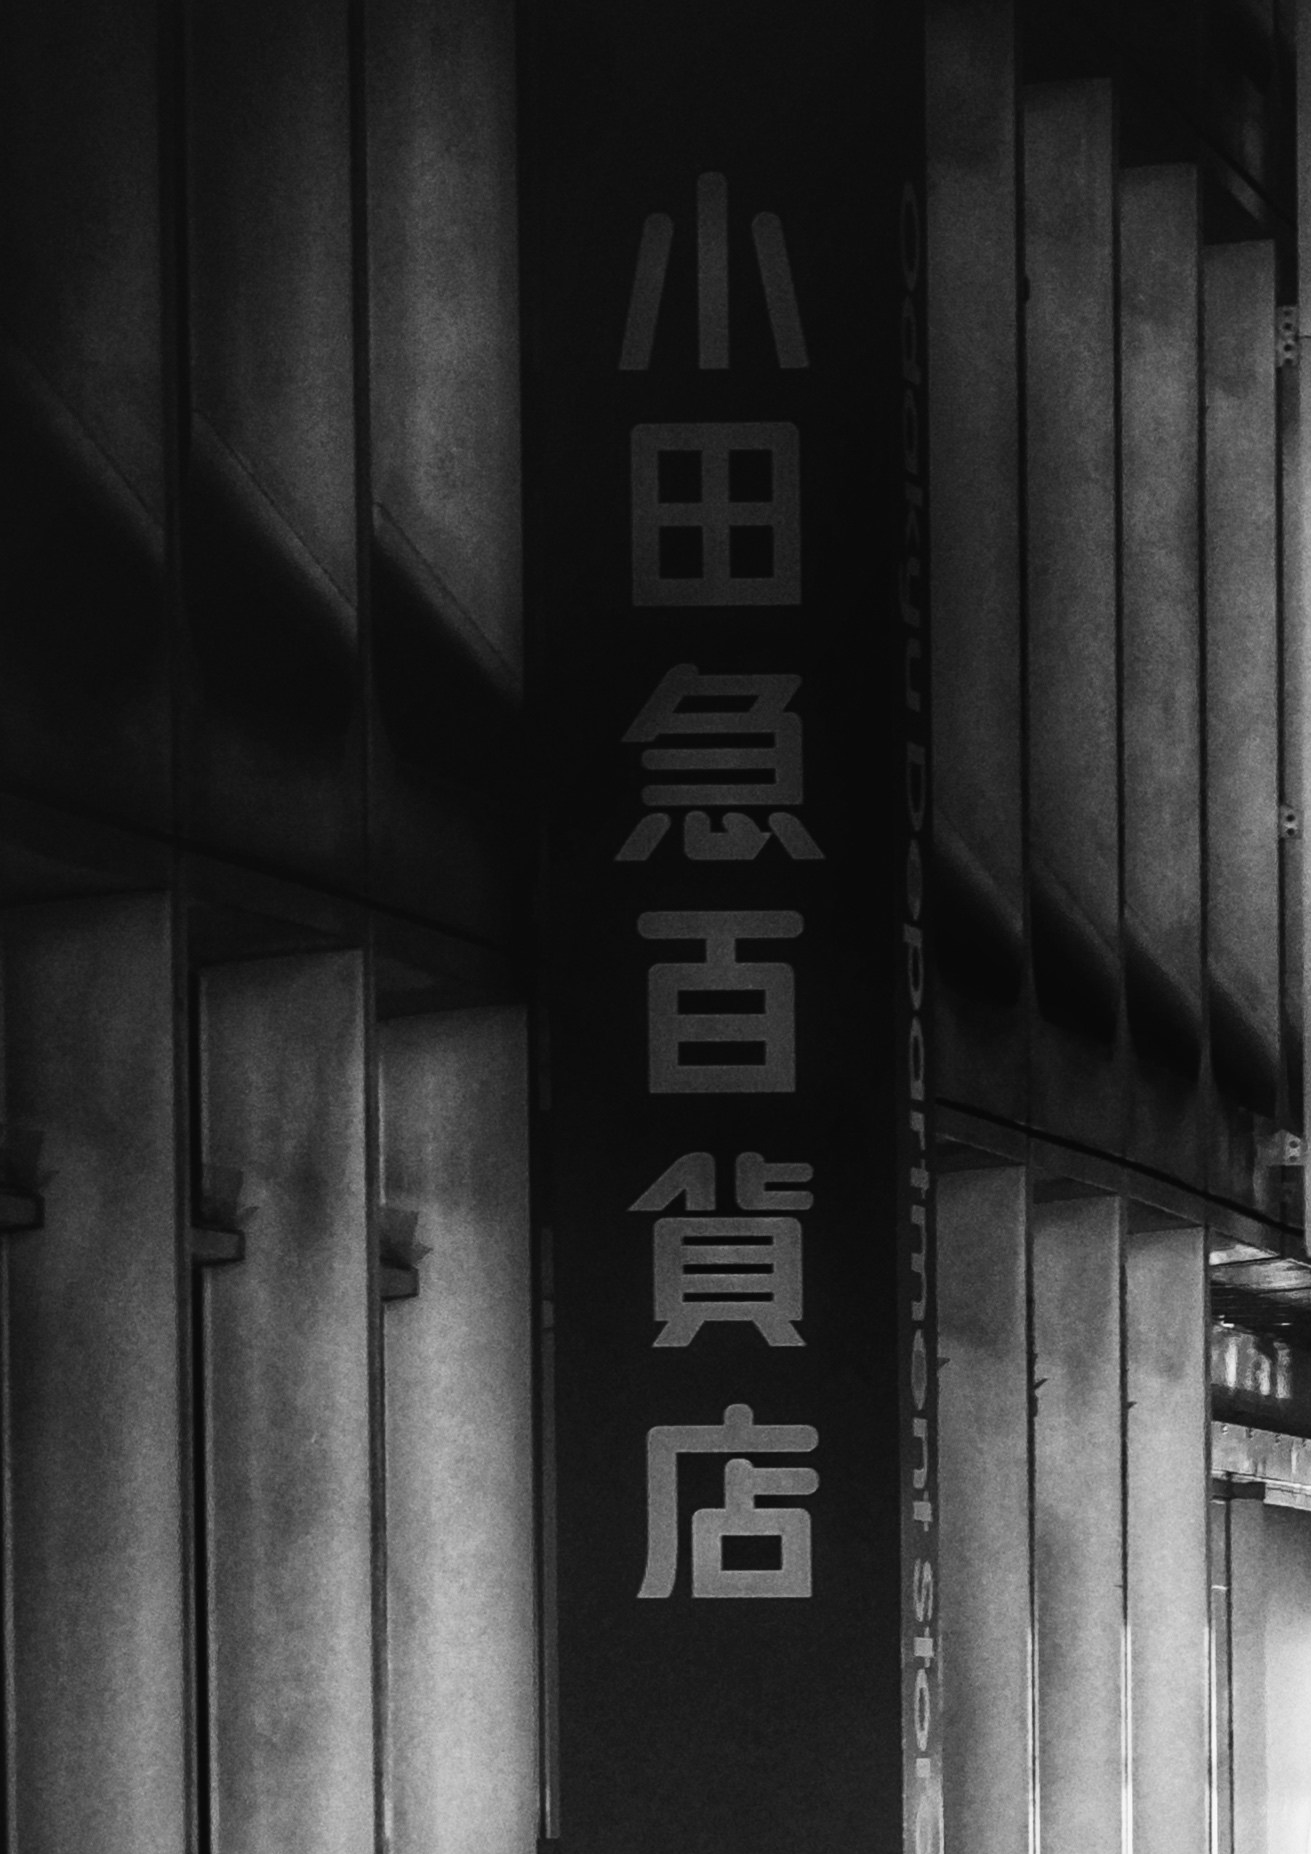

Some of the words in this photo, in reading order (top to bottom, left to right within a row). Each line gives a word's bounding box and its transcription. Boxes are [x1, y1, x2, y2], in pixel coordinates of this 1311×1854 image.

[614, 170, 826, 1598] 小田急百貨店
